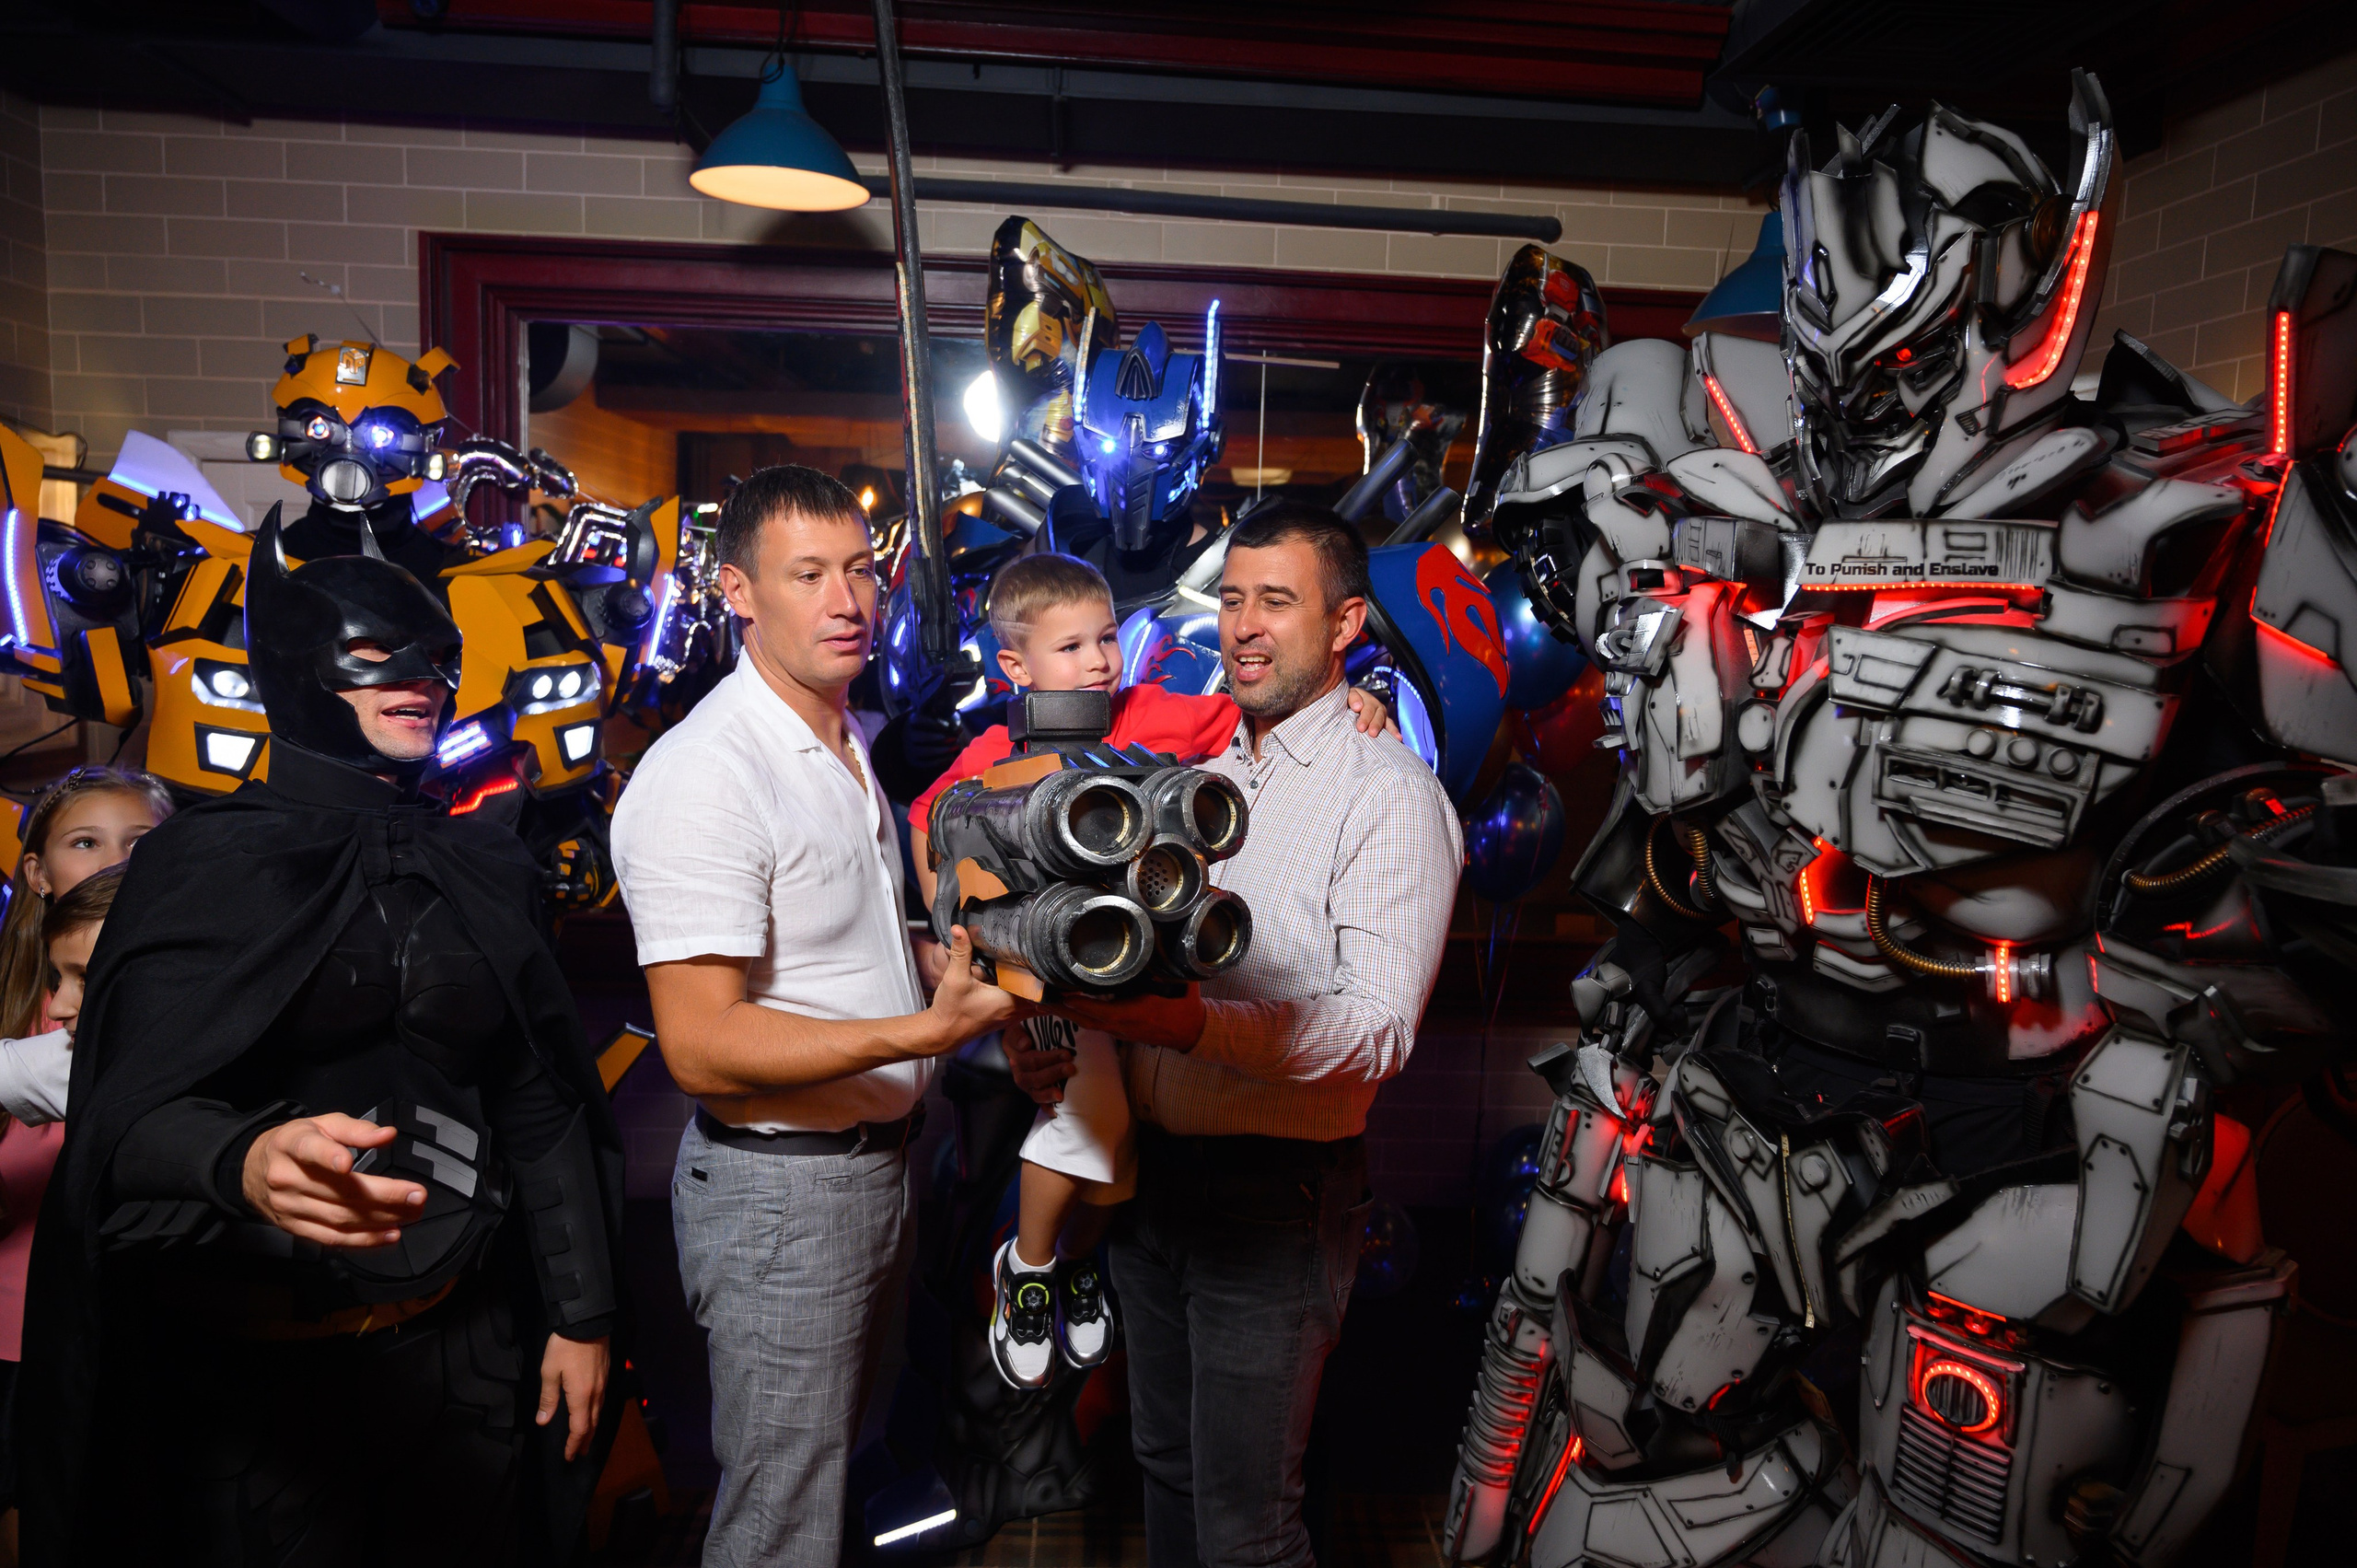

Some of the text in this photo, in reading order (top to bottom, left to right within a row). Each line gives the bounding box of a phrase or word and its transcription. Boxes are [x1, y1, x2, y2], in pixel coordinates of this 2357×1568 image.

[1805, 563, 2000, 576] To Punish and Enslave
